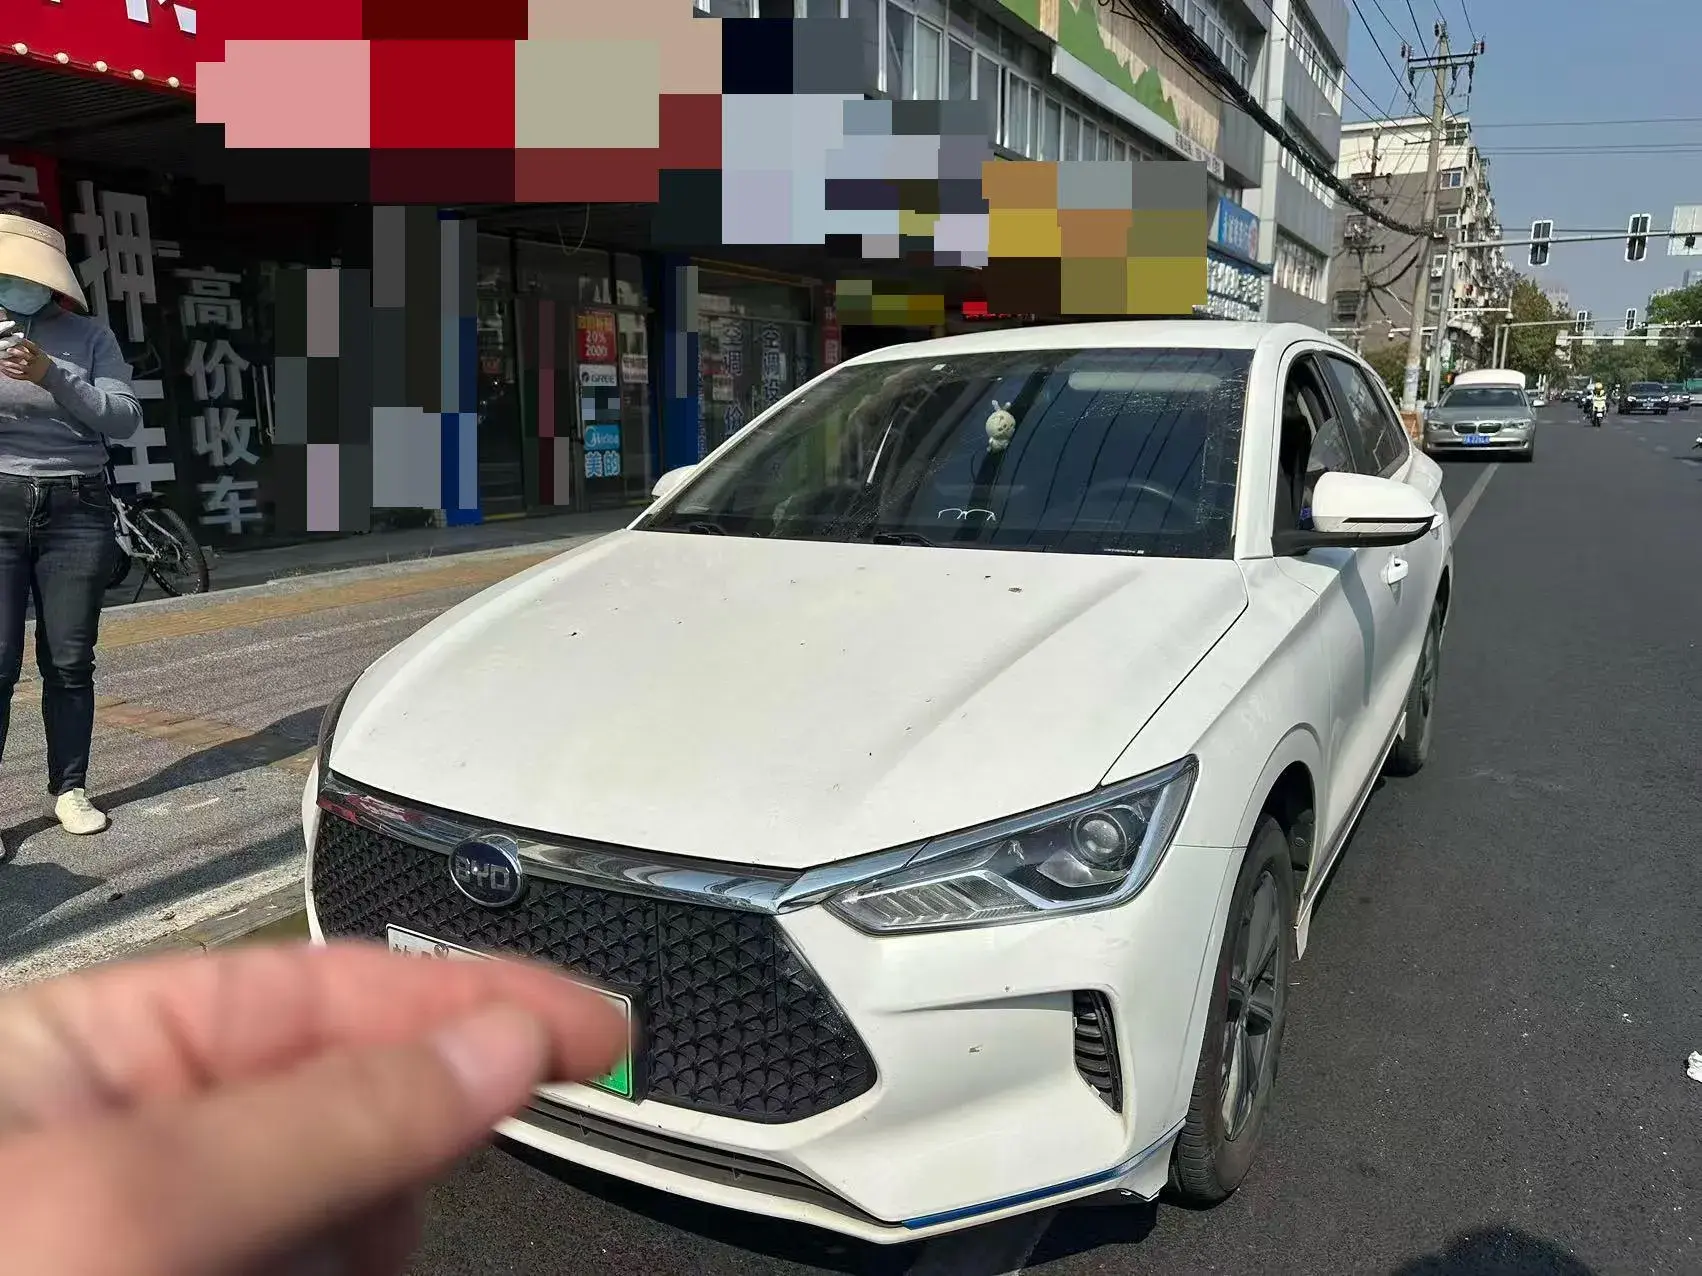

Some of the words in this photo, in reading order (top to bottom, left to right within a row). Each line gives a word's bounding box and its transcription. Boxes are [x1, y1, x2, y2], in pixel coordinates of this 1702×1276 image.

[591, 373, 615, 384] GREE
[172, 265, 264, 534] 高价收车
[585, 450, 621, 478] 美的
[455, 855, 511, 891] BYD
